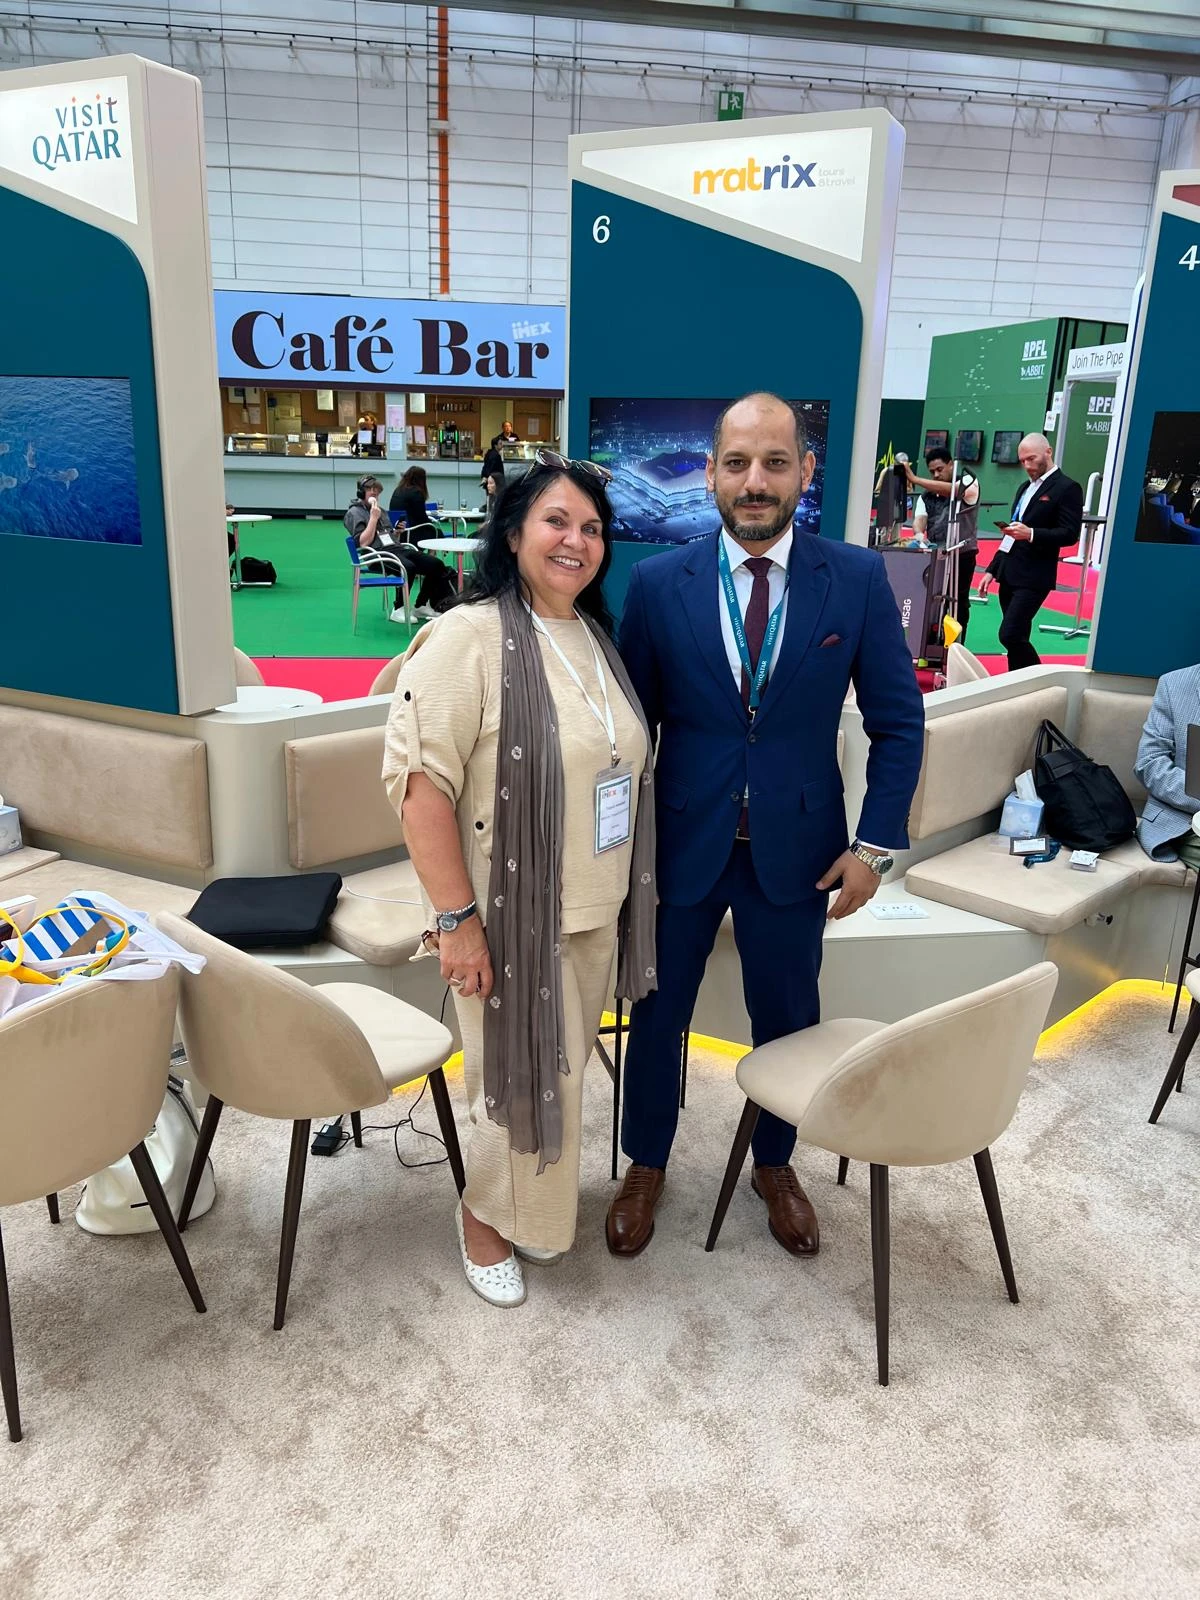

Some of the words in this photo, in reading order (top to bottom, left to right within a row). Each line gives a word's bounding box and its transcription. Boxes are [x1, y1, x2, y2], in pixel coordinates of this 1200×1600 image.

[55, 94, 118, 129] visit
[32, 129, 122, 171] QATAR
[693, 154, 818, 194] matrix
[818, 167, 845, 177] tours
[592, 215, 611, 244] 6
[1179, 245, 1200, 271] 4
[232, 310, 394, 373] Café
[413, 318, 549, 379] Bar
[1072, 354, 1089, 369] Join
[1090, 352, 1104, 368] The
[1106, 351, 1124, 368] Pipe
